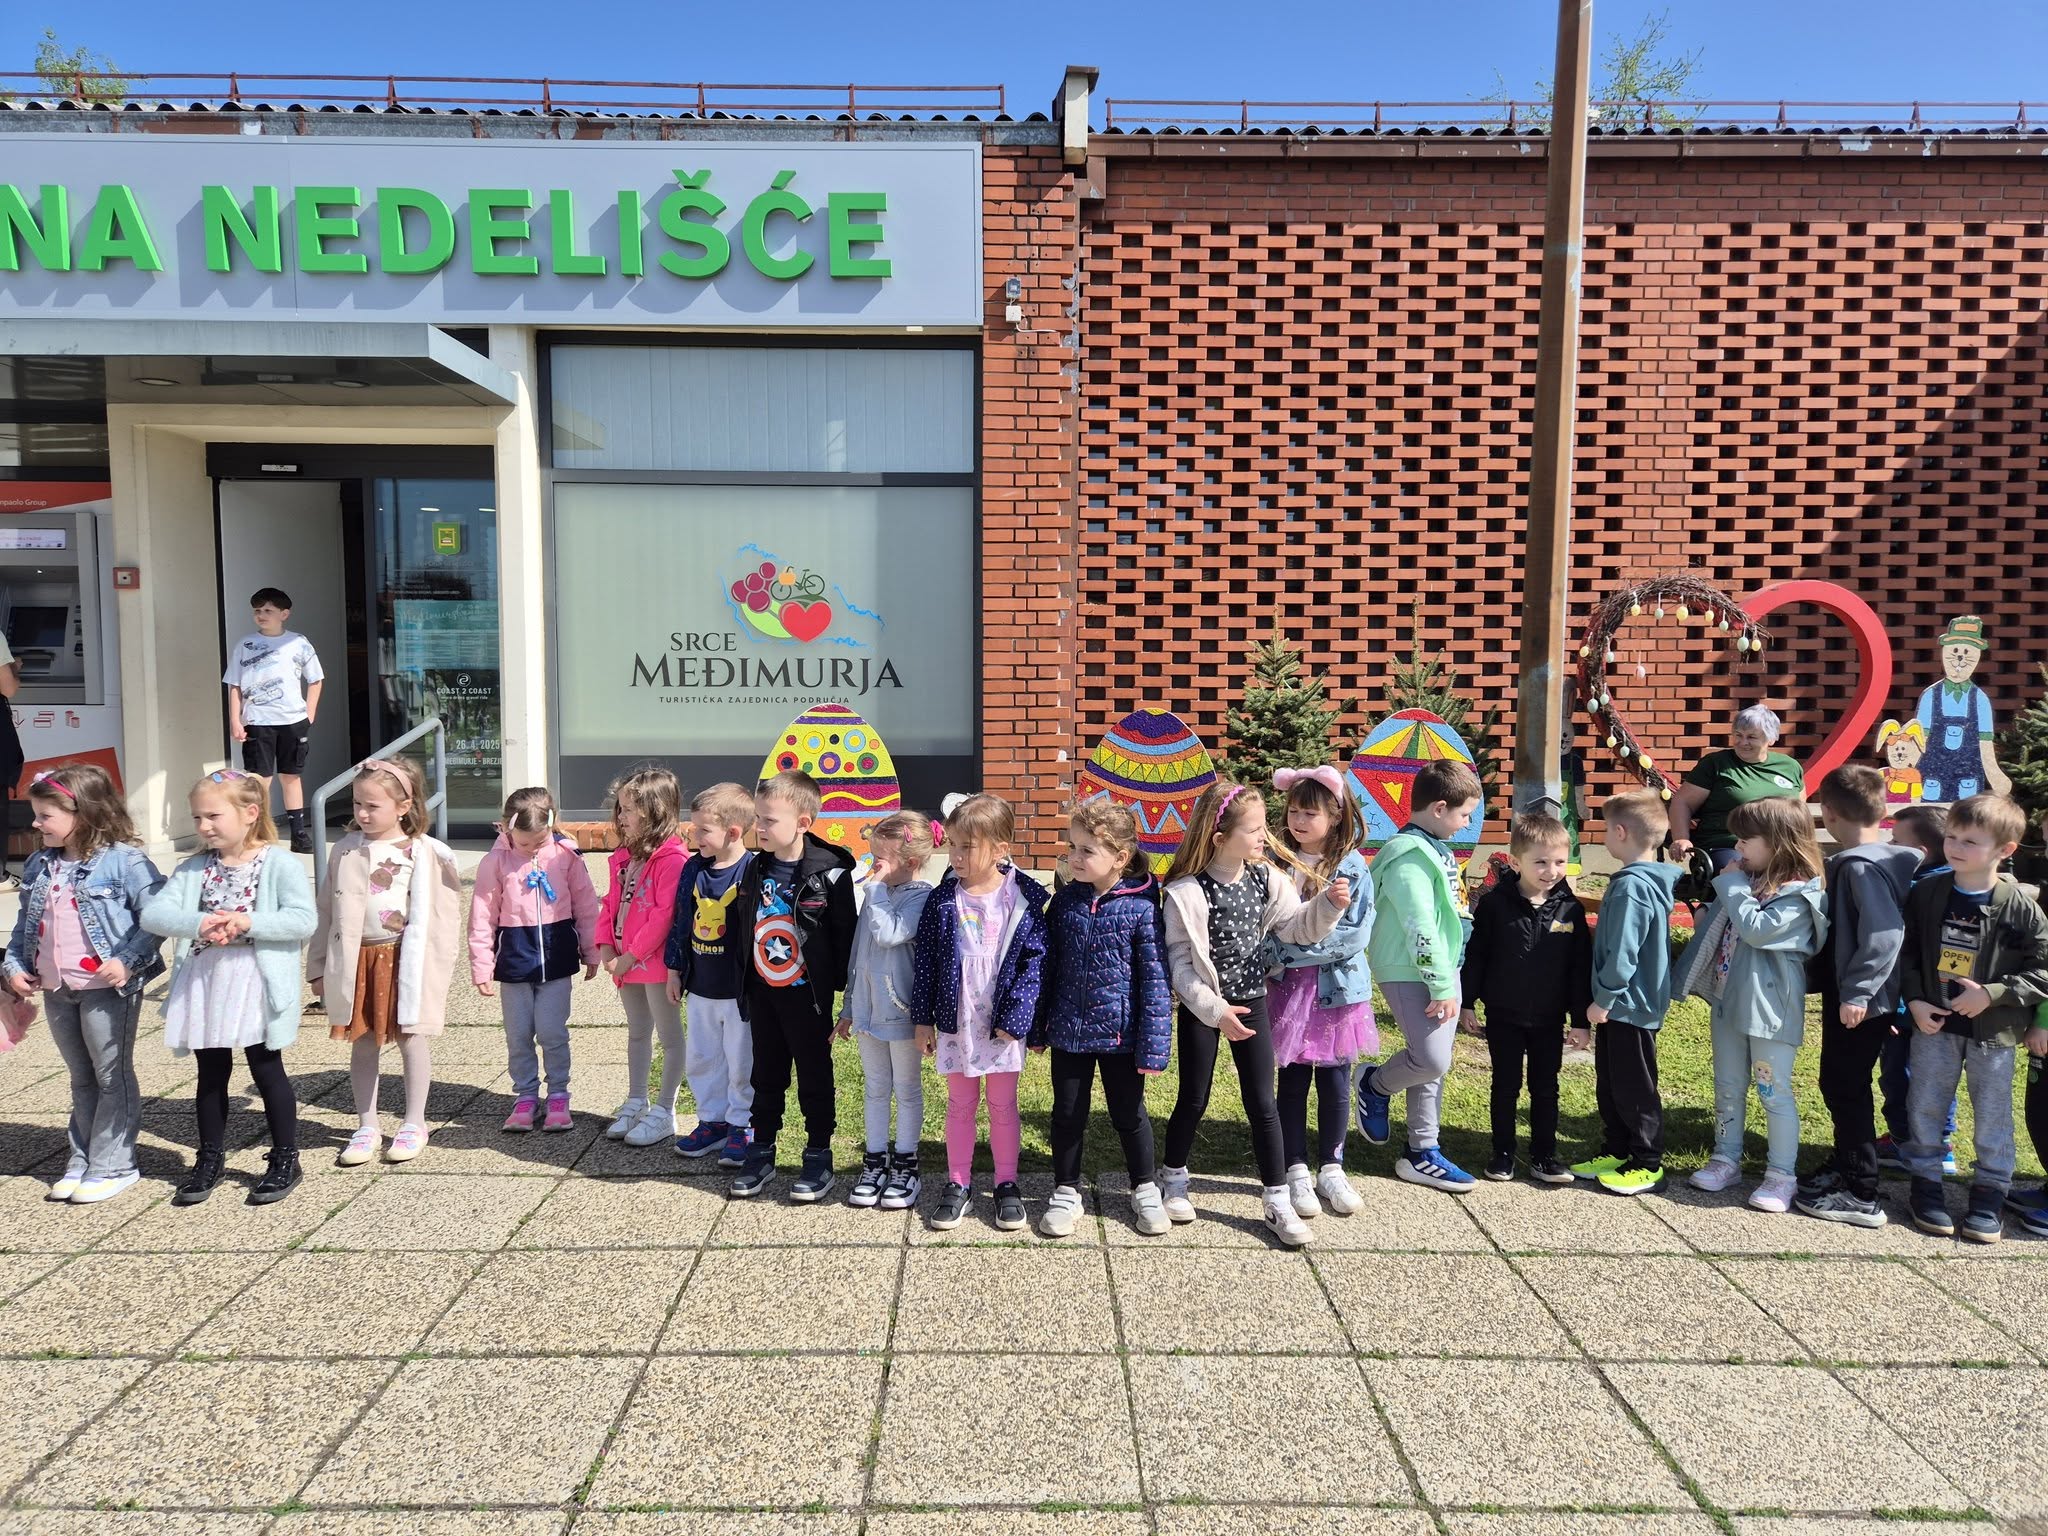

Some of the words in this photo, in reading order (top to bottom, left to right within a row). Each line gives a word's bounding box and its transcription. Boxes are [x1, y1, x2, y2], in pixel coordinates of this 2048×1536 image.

[201, 169, 893, 280] NEDELIŠĆE
[24, 498, 47, 507] Group
[670, 632, 737, 651] SRCE
[629, 652, 904, 696] MEĐIMURJA
[659, 695, 723, 703] TURISTIČKA
[793, 695, 850, 703] PODRUČJA
[1943, 950, 1970, 963] OPEN
